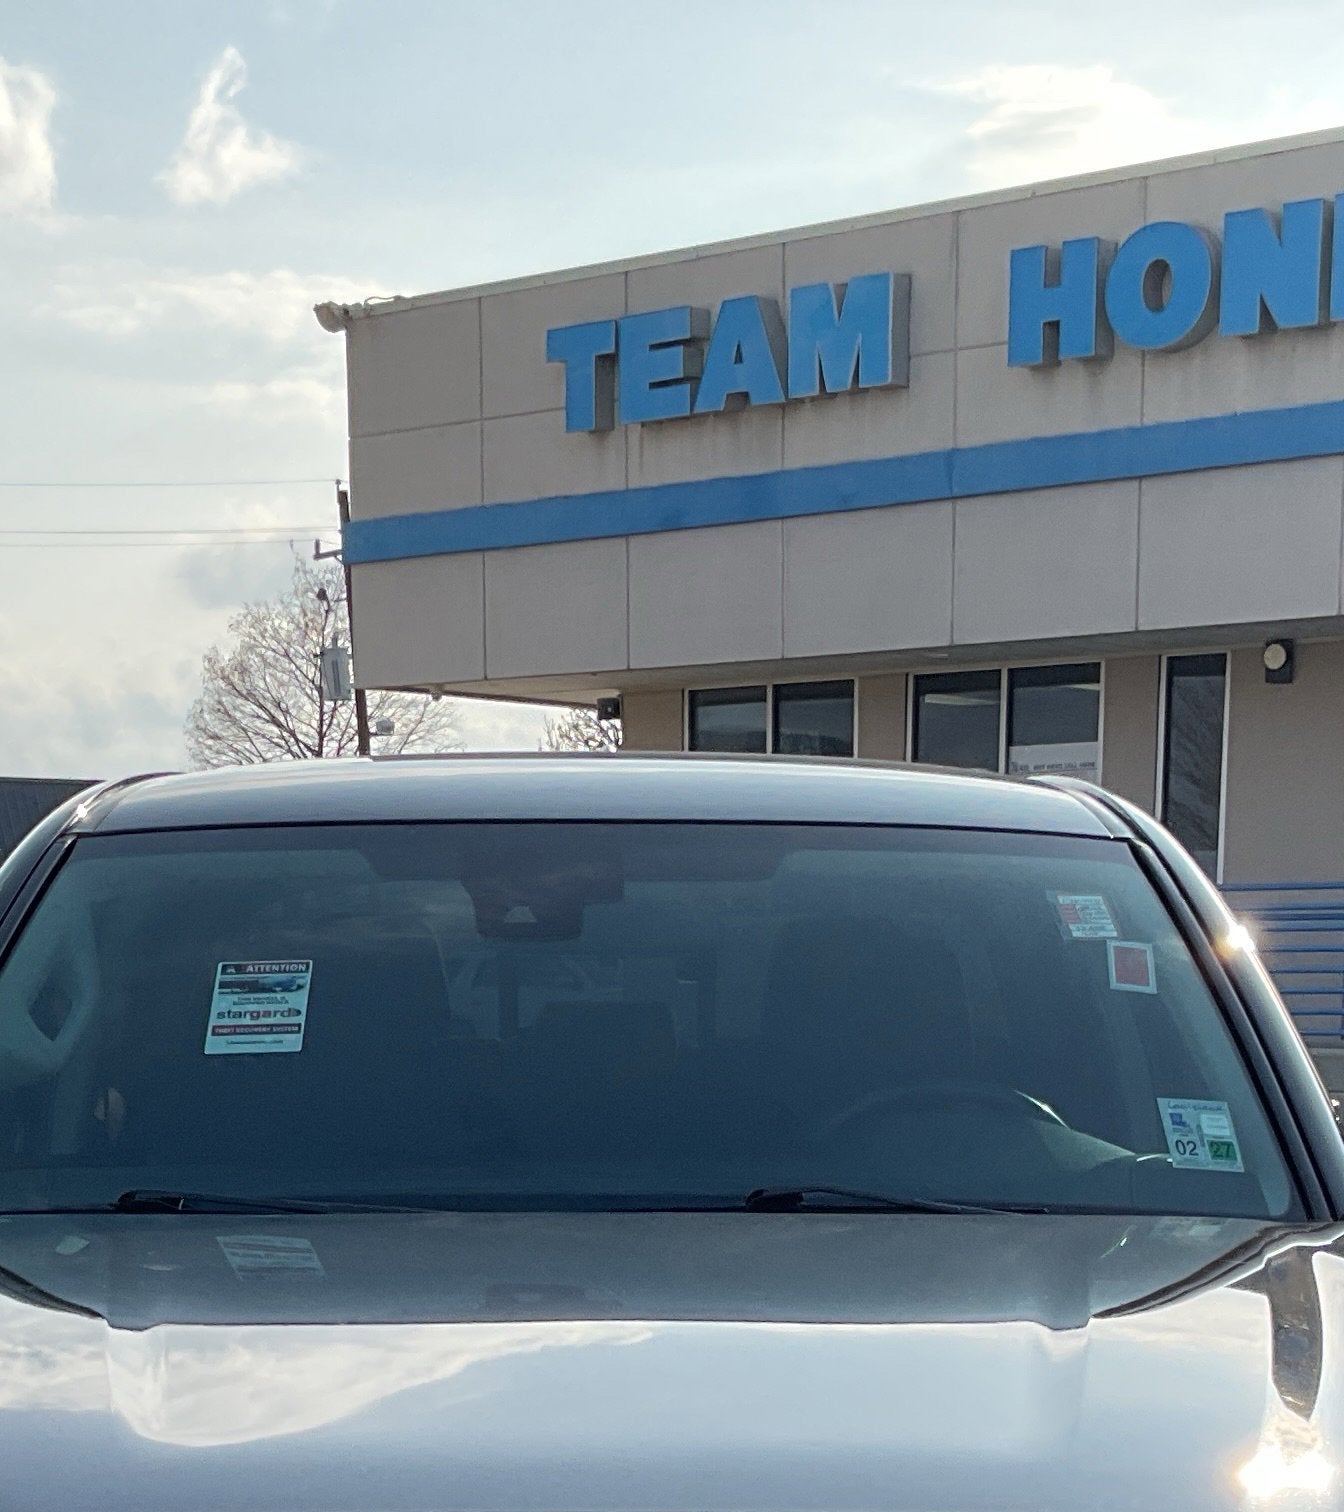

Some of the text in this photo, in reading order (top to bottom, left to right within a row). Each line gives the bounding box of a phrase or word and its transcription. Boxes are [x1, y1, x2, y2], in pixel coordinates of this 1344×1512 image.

[547, 271, 903, 432] TEAM
[246, 963, 307, 973] ATTENTION
[216, 1007, 293, 1021] stargard
[1174, 1139, 1233, 1158] 02 27
